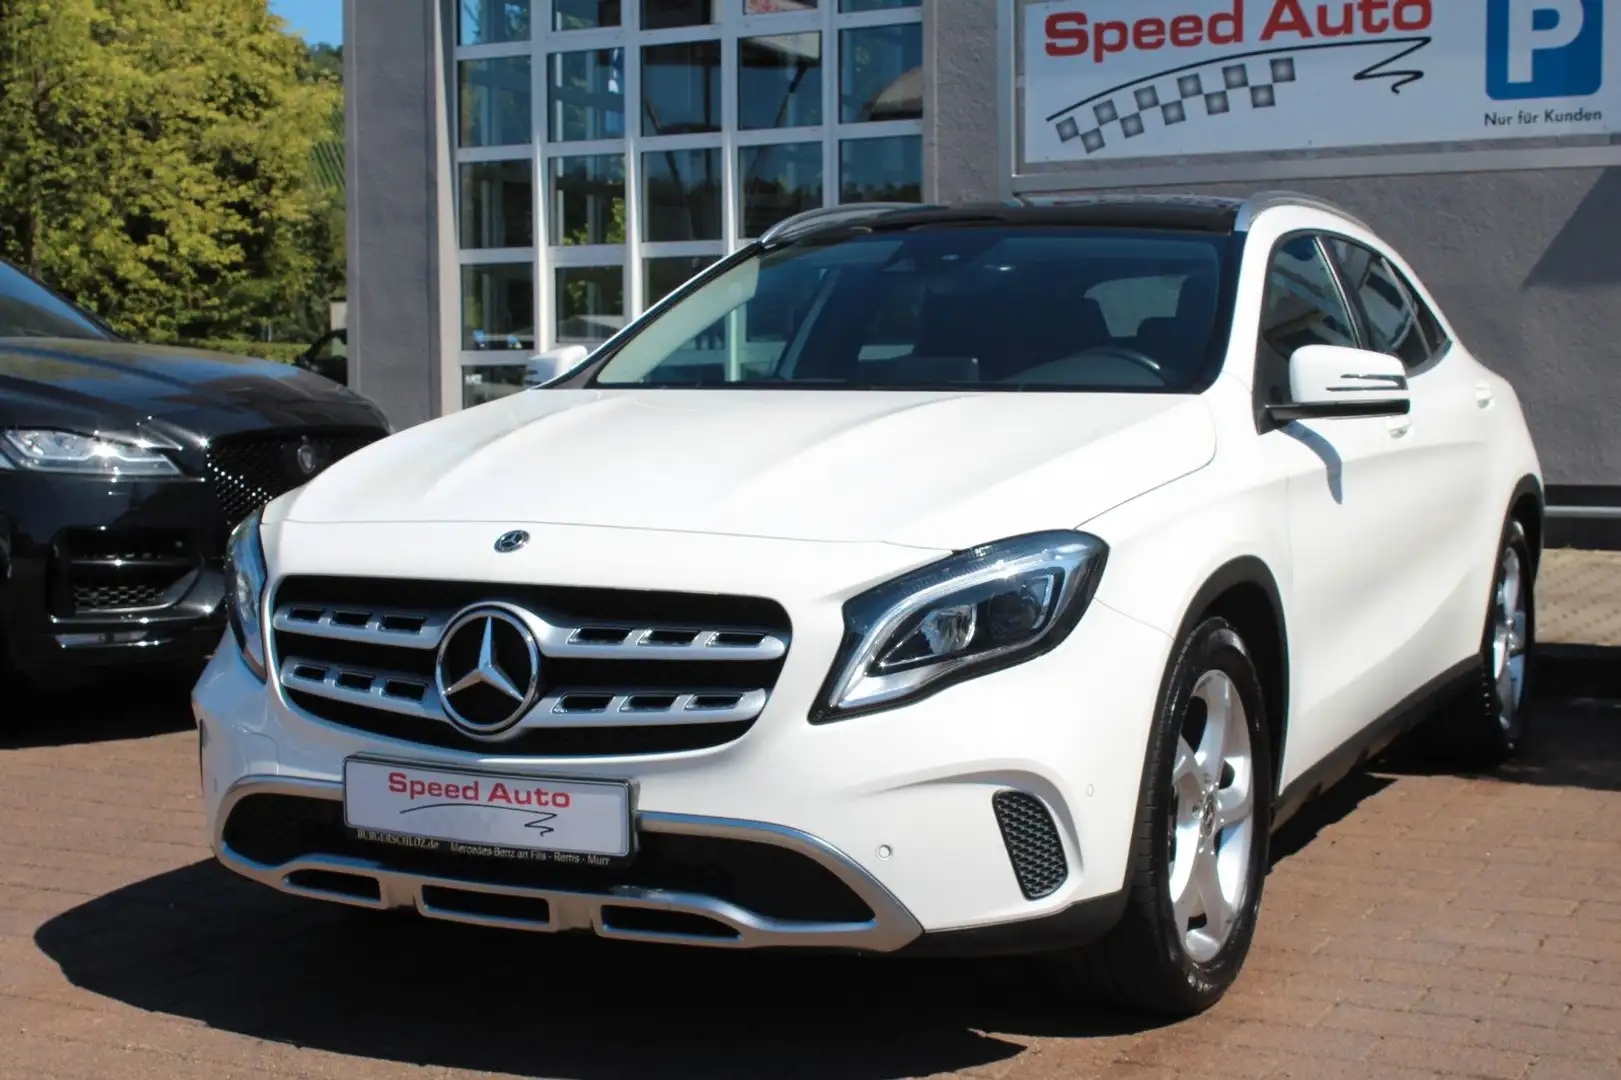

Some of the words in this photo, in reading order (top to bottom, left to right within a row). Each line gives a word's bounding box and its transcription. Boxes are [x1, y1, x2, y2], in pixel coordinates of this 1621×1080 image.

[1044, 0, 1244, 62] Speed
[1260, 0, 1433, 40] Auto
[1507, 0, 1584, 84] P
[1484, 112, 1513, 127] Nur
[1517, 110, 1540, 125] für
[1543, 107, 1602, 123] Kunden
[388, 771, 479, 801] Speed
[488, 782, 571, 808] Auto
[554, 852, 580, 864] Rems
[588, 855, 611, 867] Murr
